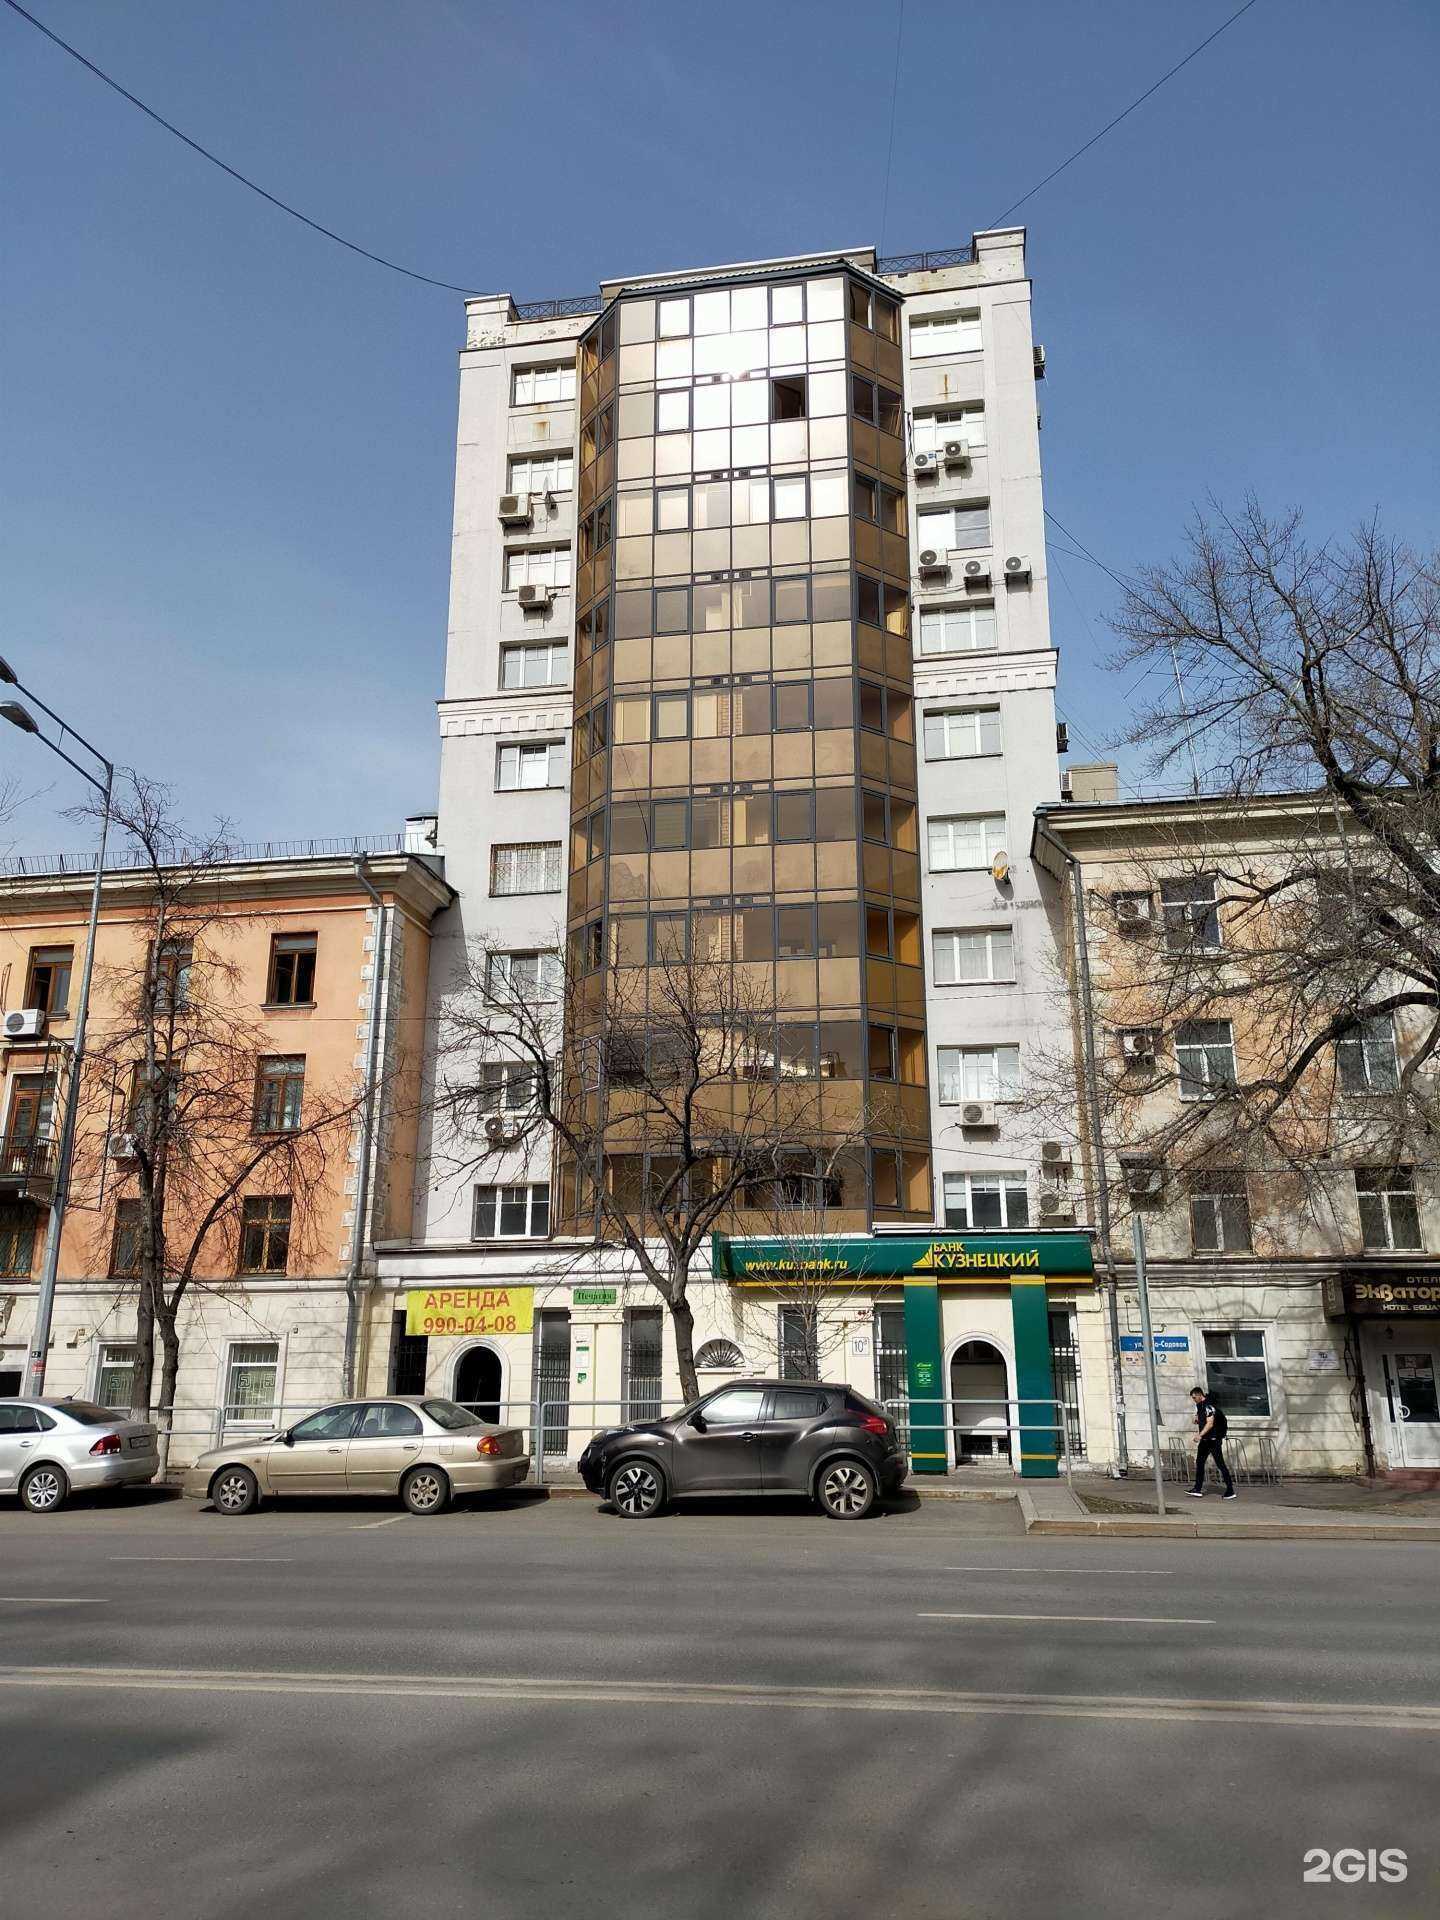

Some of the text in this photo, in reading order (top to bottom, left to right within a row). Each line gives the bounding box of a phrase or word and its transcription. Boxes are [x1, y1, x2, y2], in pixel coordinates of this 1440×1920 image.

[933, 1242, 965, 1252] БАНК
[933, 1249, 1040, 1269] КУЗНЕЦКИЙ
[1406, 1276, 1440, 1284] ОТЕЛ
[424, 1290, 510, 1312] АРЕНДА
[423, 1315, 516, 1334] 990-04-08
